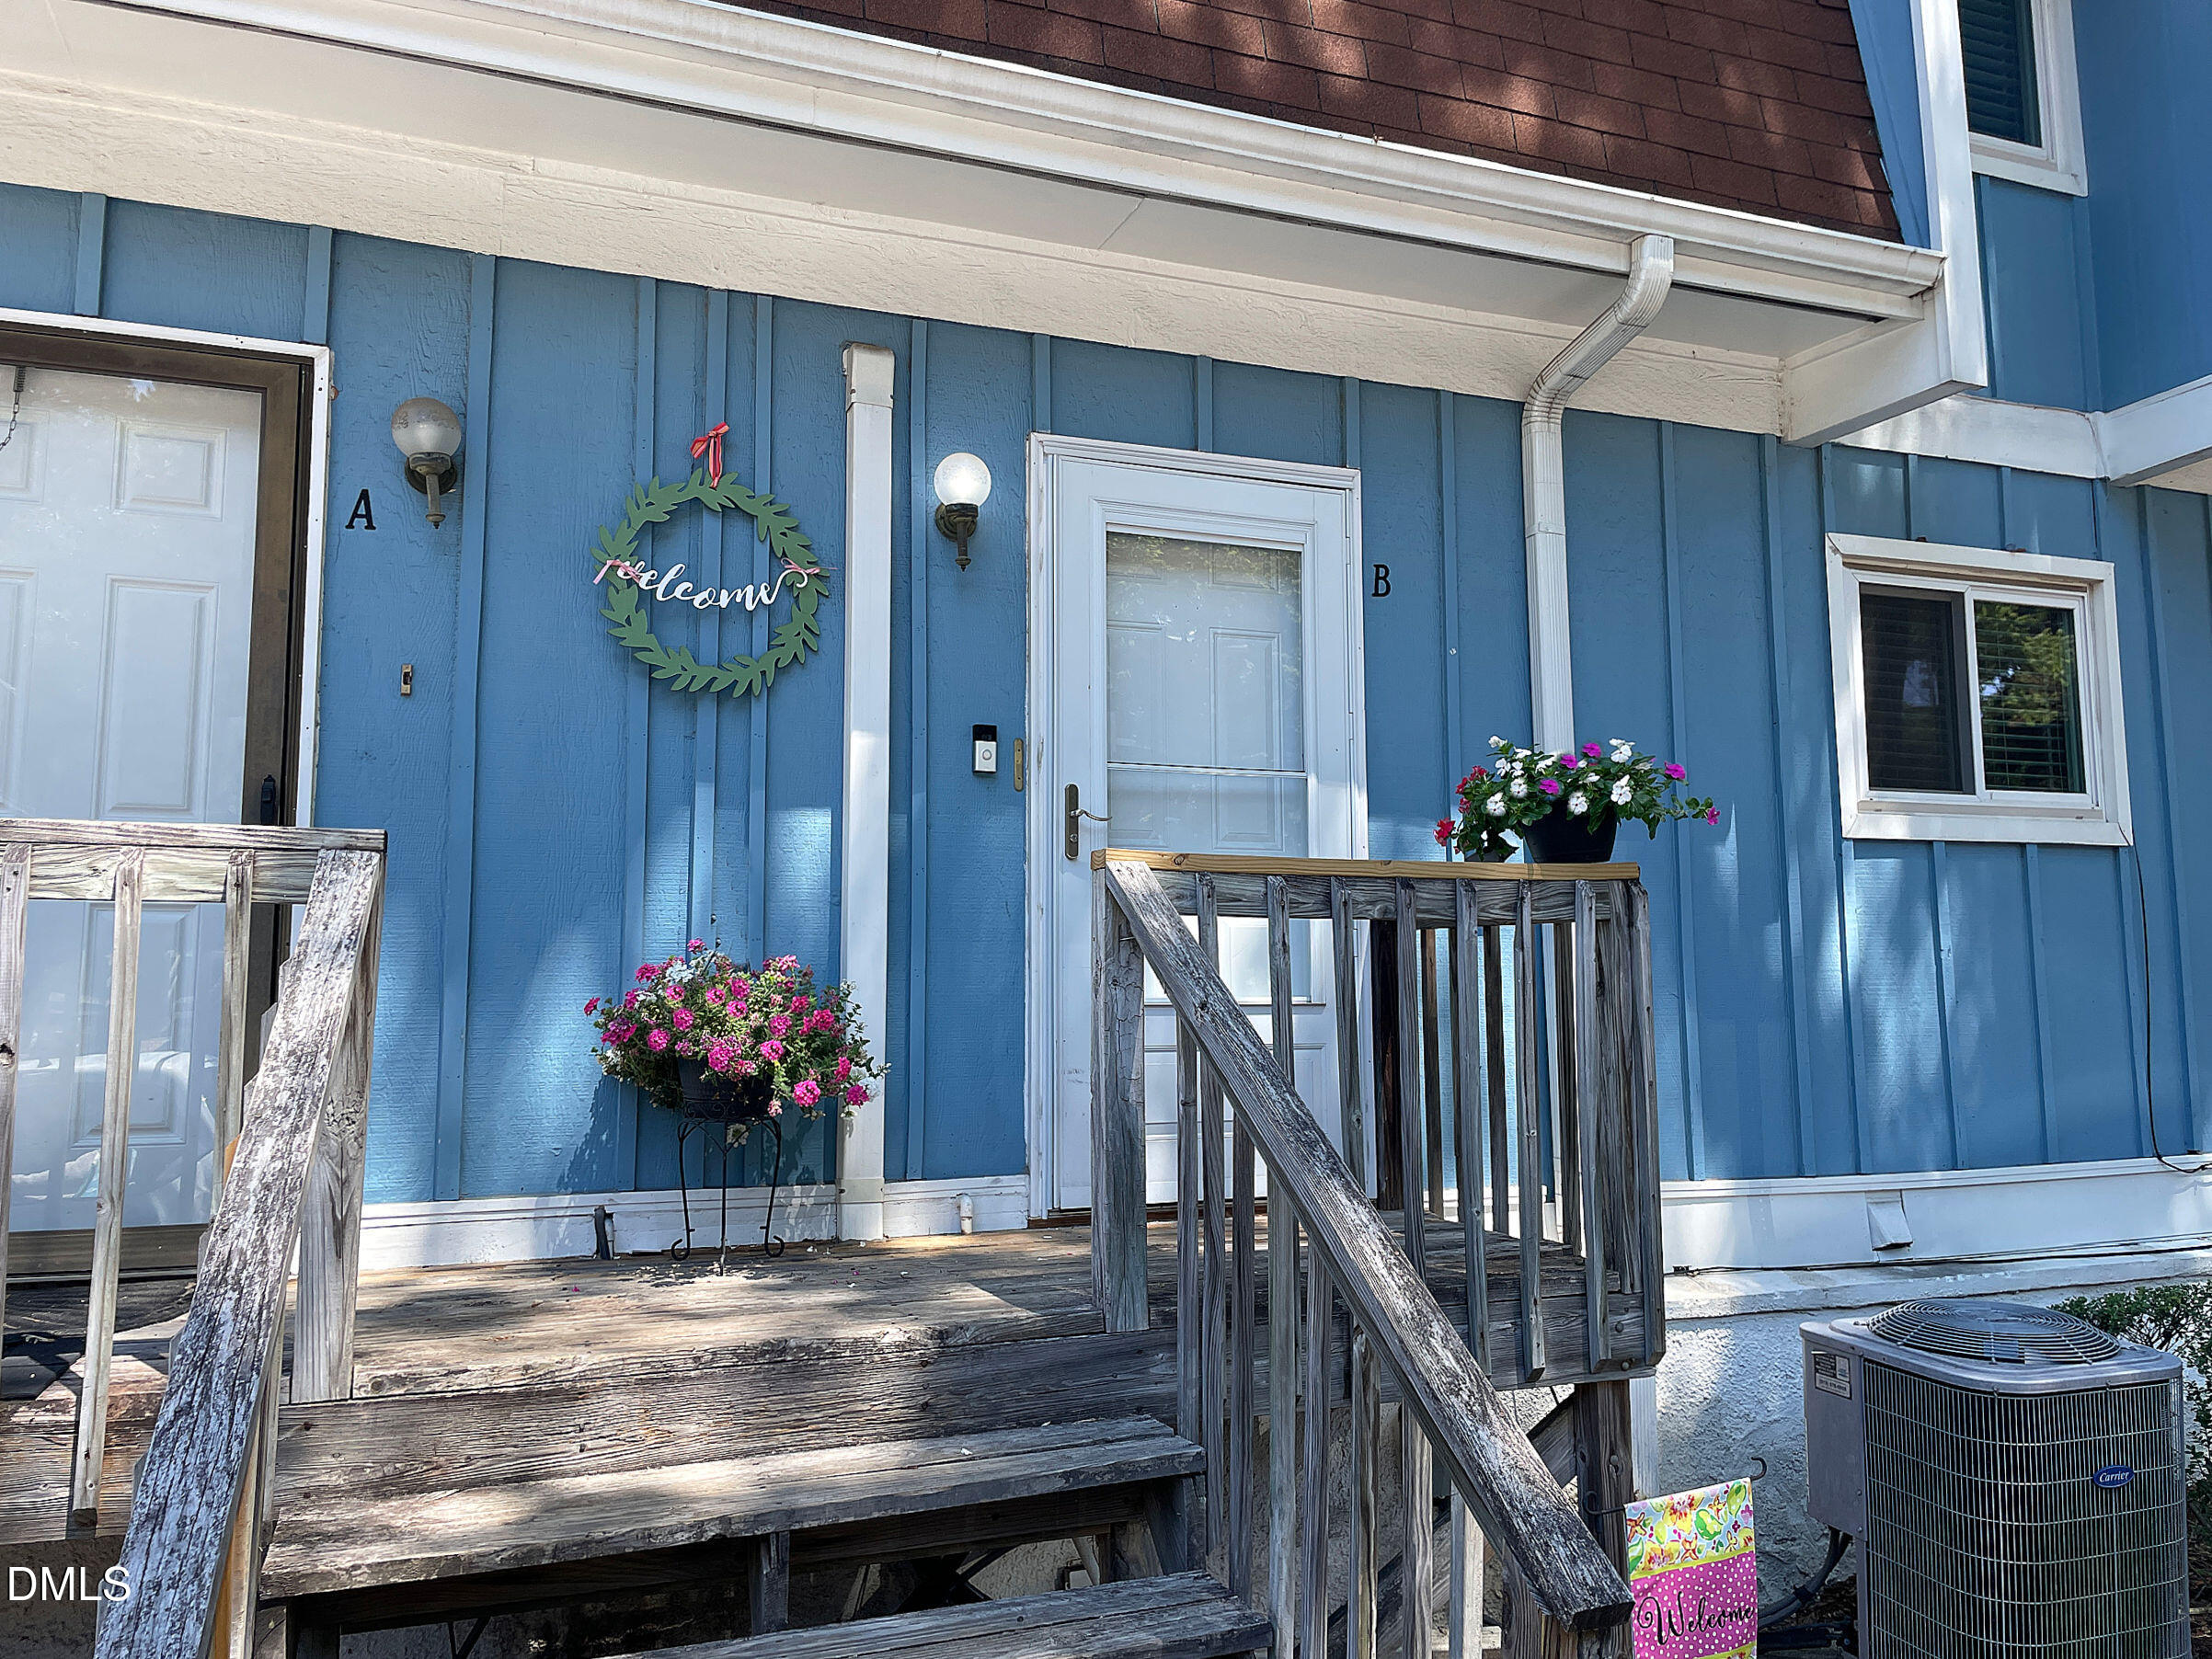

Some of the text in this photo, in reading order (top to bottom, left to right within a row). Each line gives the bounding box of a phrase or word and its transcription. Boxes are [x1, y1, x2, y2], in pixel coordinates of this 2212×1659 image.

[345, 488, 376, 531] A
[1372, 564, 1392, 598] B
[2099, 1470, 2130, 1482] Carrier
[1636, 1591, 1755, 1645] Welcome
